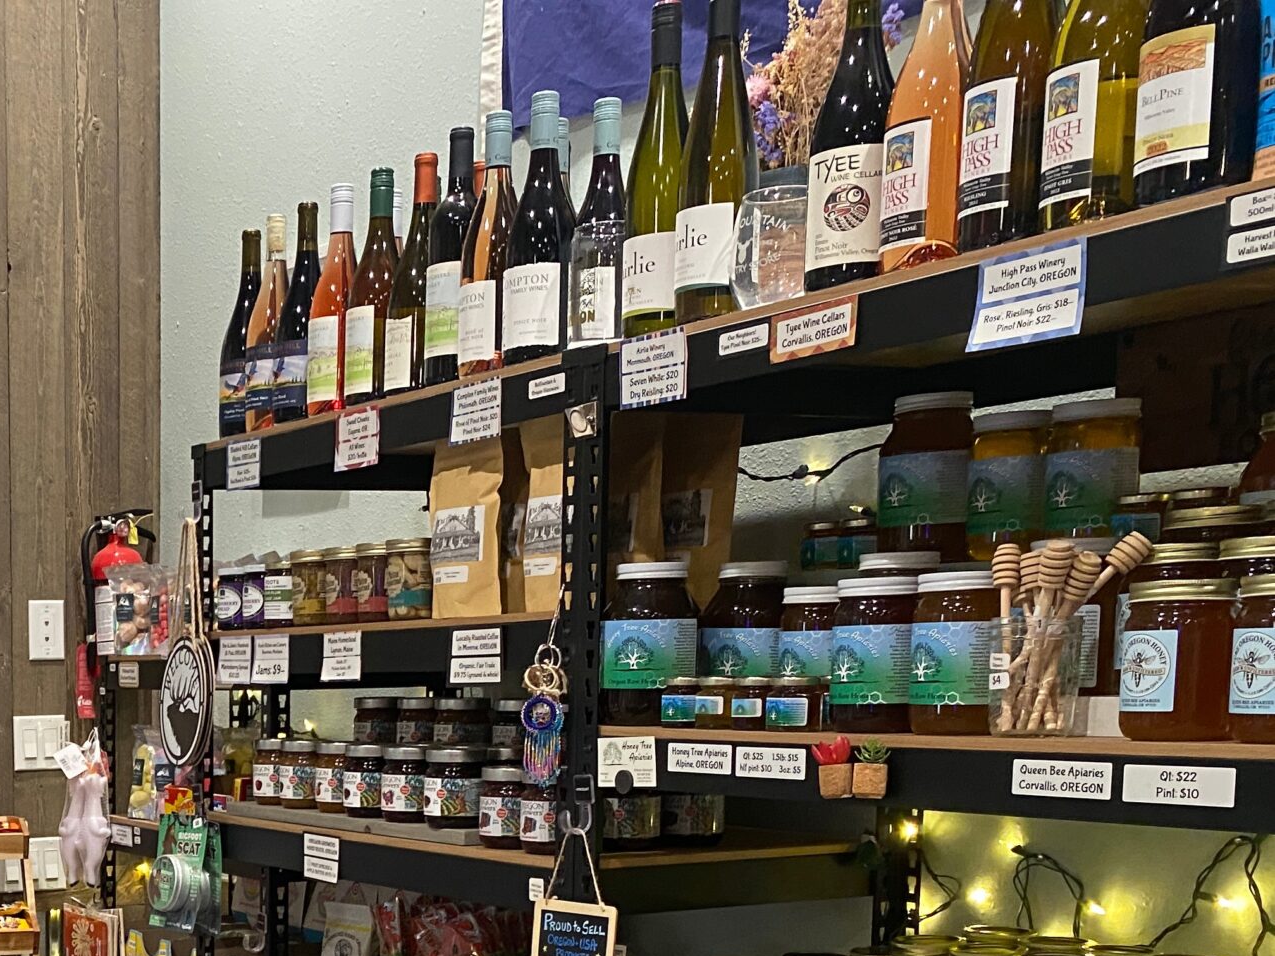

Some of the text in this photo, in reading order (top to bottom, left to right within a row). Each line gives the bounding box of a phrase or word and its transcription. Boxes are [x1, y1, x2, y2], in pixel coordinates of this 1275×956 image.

[1047, 137, 1073, 159] PASS
[815, 154, 860, 183] TYEE
[965, 151, 991, 173] PASS
[885, 190, 909, 210] PASS
[1001, 258, 1065, 279] High Pass Winery
[989, 282, 1019, 294] Junction
[1040, 266, 1077, 282] OREGON
[786, 311, 845, 335] Tyee Wine Cellars
[996, 322, 1015, 332] Pinot
[815, 324, 848, 340] OREGON
[653, 352, 674, 362] OREGON
[630, 370, 678, 387] Seven $20
[630, 383, 678, 400] Dry $20
[992, 676, 1001, 685] $4
[622, 741, 639, 750] Honey
[672, 747, 728, 758] Honey Tree Apiaries
[629, 753, 652, 761] Apiaries
[696, 760, 723, 769] OREGON
[760, 764, 801, 774] $10 $5
[1020, 765, 1104, 779] Queen Bee Apiaries
[1176, 771, 1196, 782] $22
[1061, 781, 1103, 794] OREGON
[1179, 788, 1199, 799] $10
[178, 842, 200, 856] SCAT
[544, 913, 605, 935] PROUD to SELL
